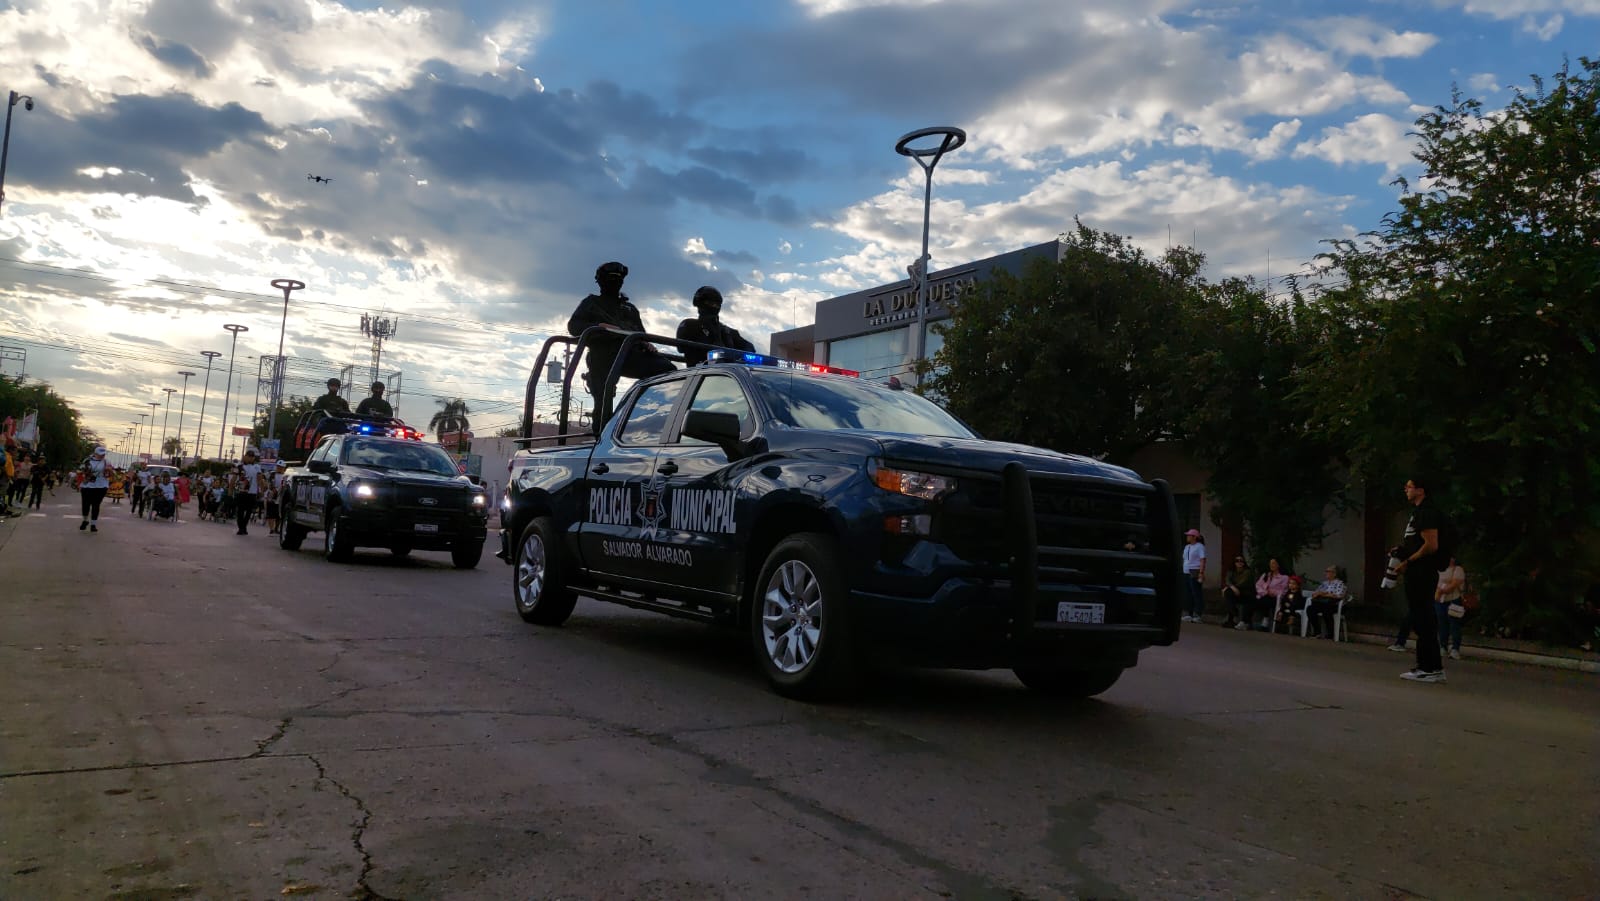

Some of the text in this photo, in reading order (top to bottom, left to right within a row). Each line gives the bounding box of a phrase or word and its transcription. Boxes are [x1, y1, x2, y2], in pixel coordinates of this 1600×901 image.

[863, 299, 885, 318] LA
[671, 488, 737, 533] MUNICIPAL
[603, 540, 693, 567] SALVADOR ALVARADO
